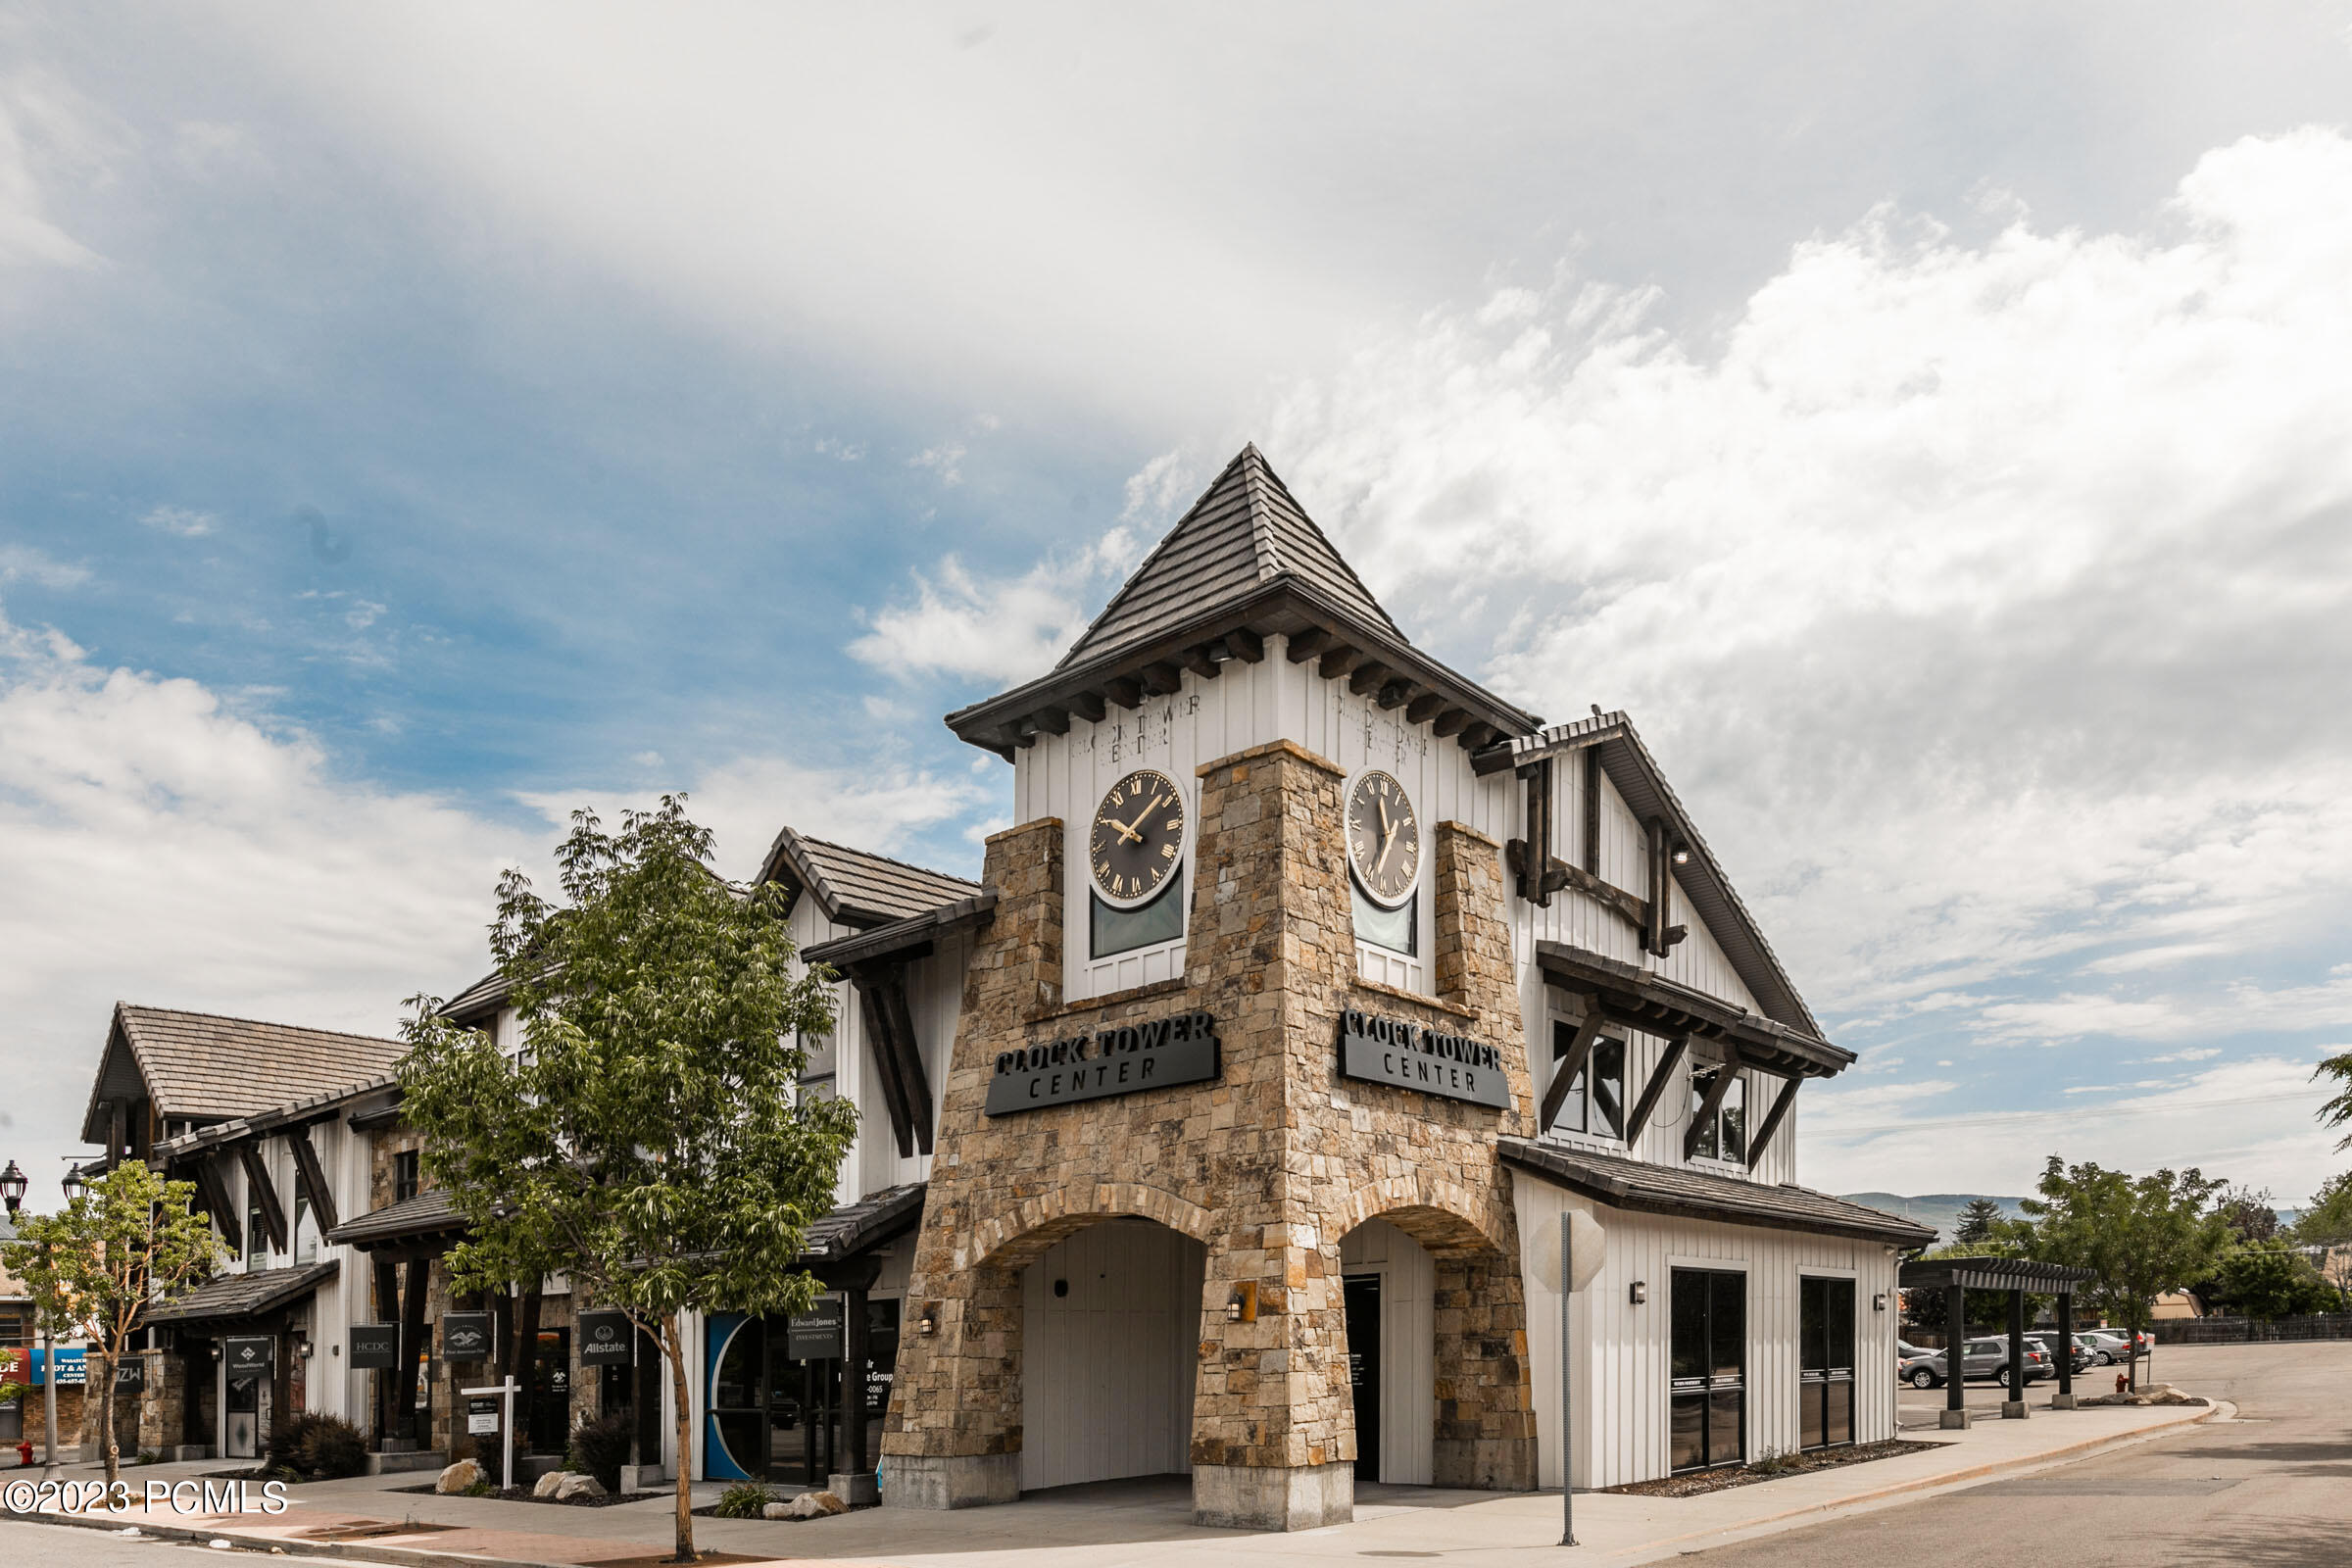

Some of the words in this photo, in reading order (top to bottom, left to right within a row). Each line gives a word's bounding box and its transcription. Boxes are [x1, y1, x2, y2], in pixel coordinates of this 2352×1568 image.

[995, 1035, 1088, 1076] CLOCK
[1096, 1010, 1213, 1057] TOWER
[1342, 1008, 1420, 1052] CLOCK
[1422, 1030, 1502, 1071] TOWER
[1029, 1057, 1155, 1099] CENTER
[1383, 1053, 1476, 1092] CENTER
[356, 1342, 389, 1351] HCDC
[583, 1342, 626, 1354] Allstate
[871, 1371, 894, 1384] Group
